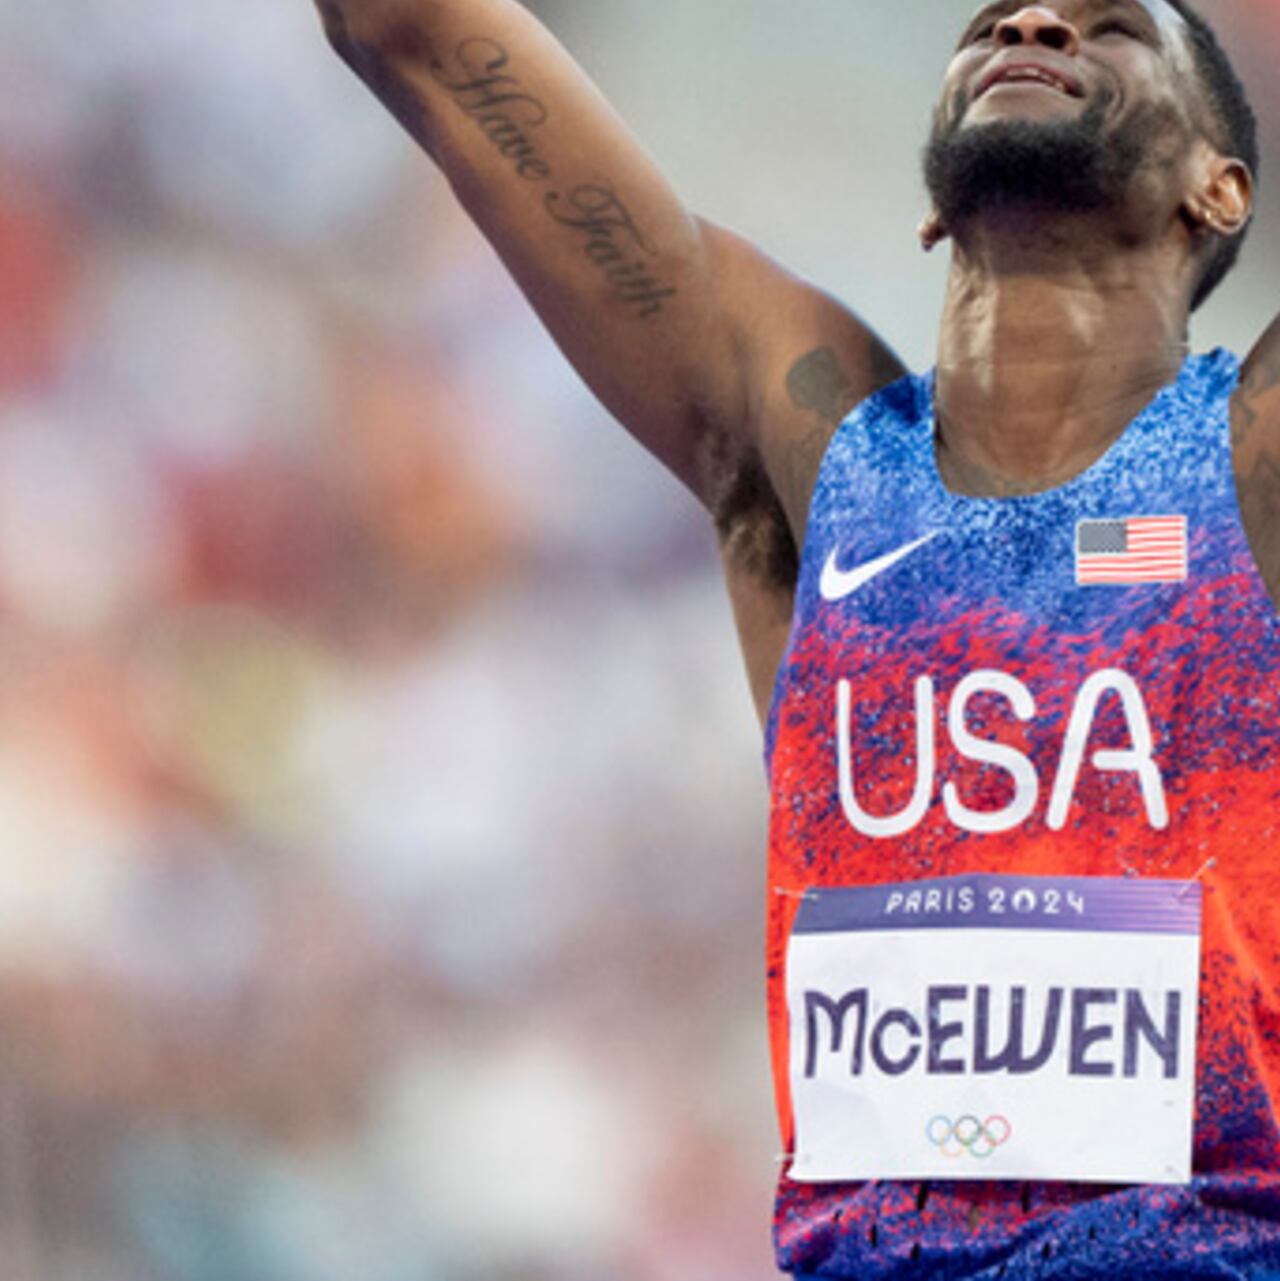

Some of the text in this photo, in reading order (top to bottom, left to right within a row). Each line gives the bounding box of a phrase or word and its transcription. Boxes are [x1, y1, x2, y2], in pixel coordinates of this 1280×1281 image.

[428, 36, 676, 318] Have Faith
[837, 668, 1168, 837] USA
[885, 887, 1084, 914] PARIS 2024
[803, 985, 1181, 1079] McEWEN
